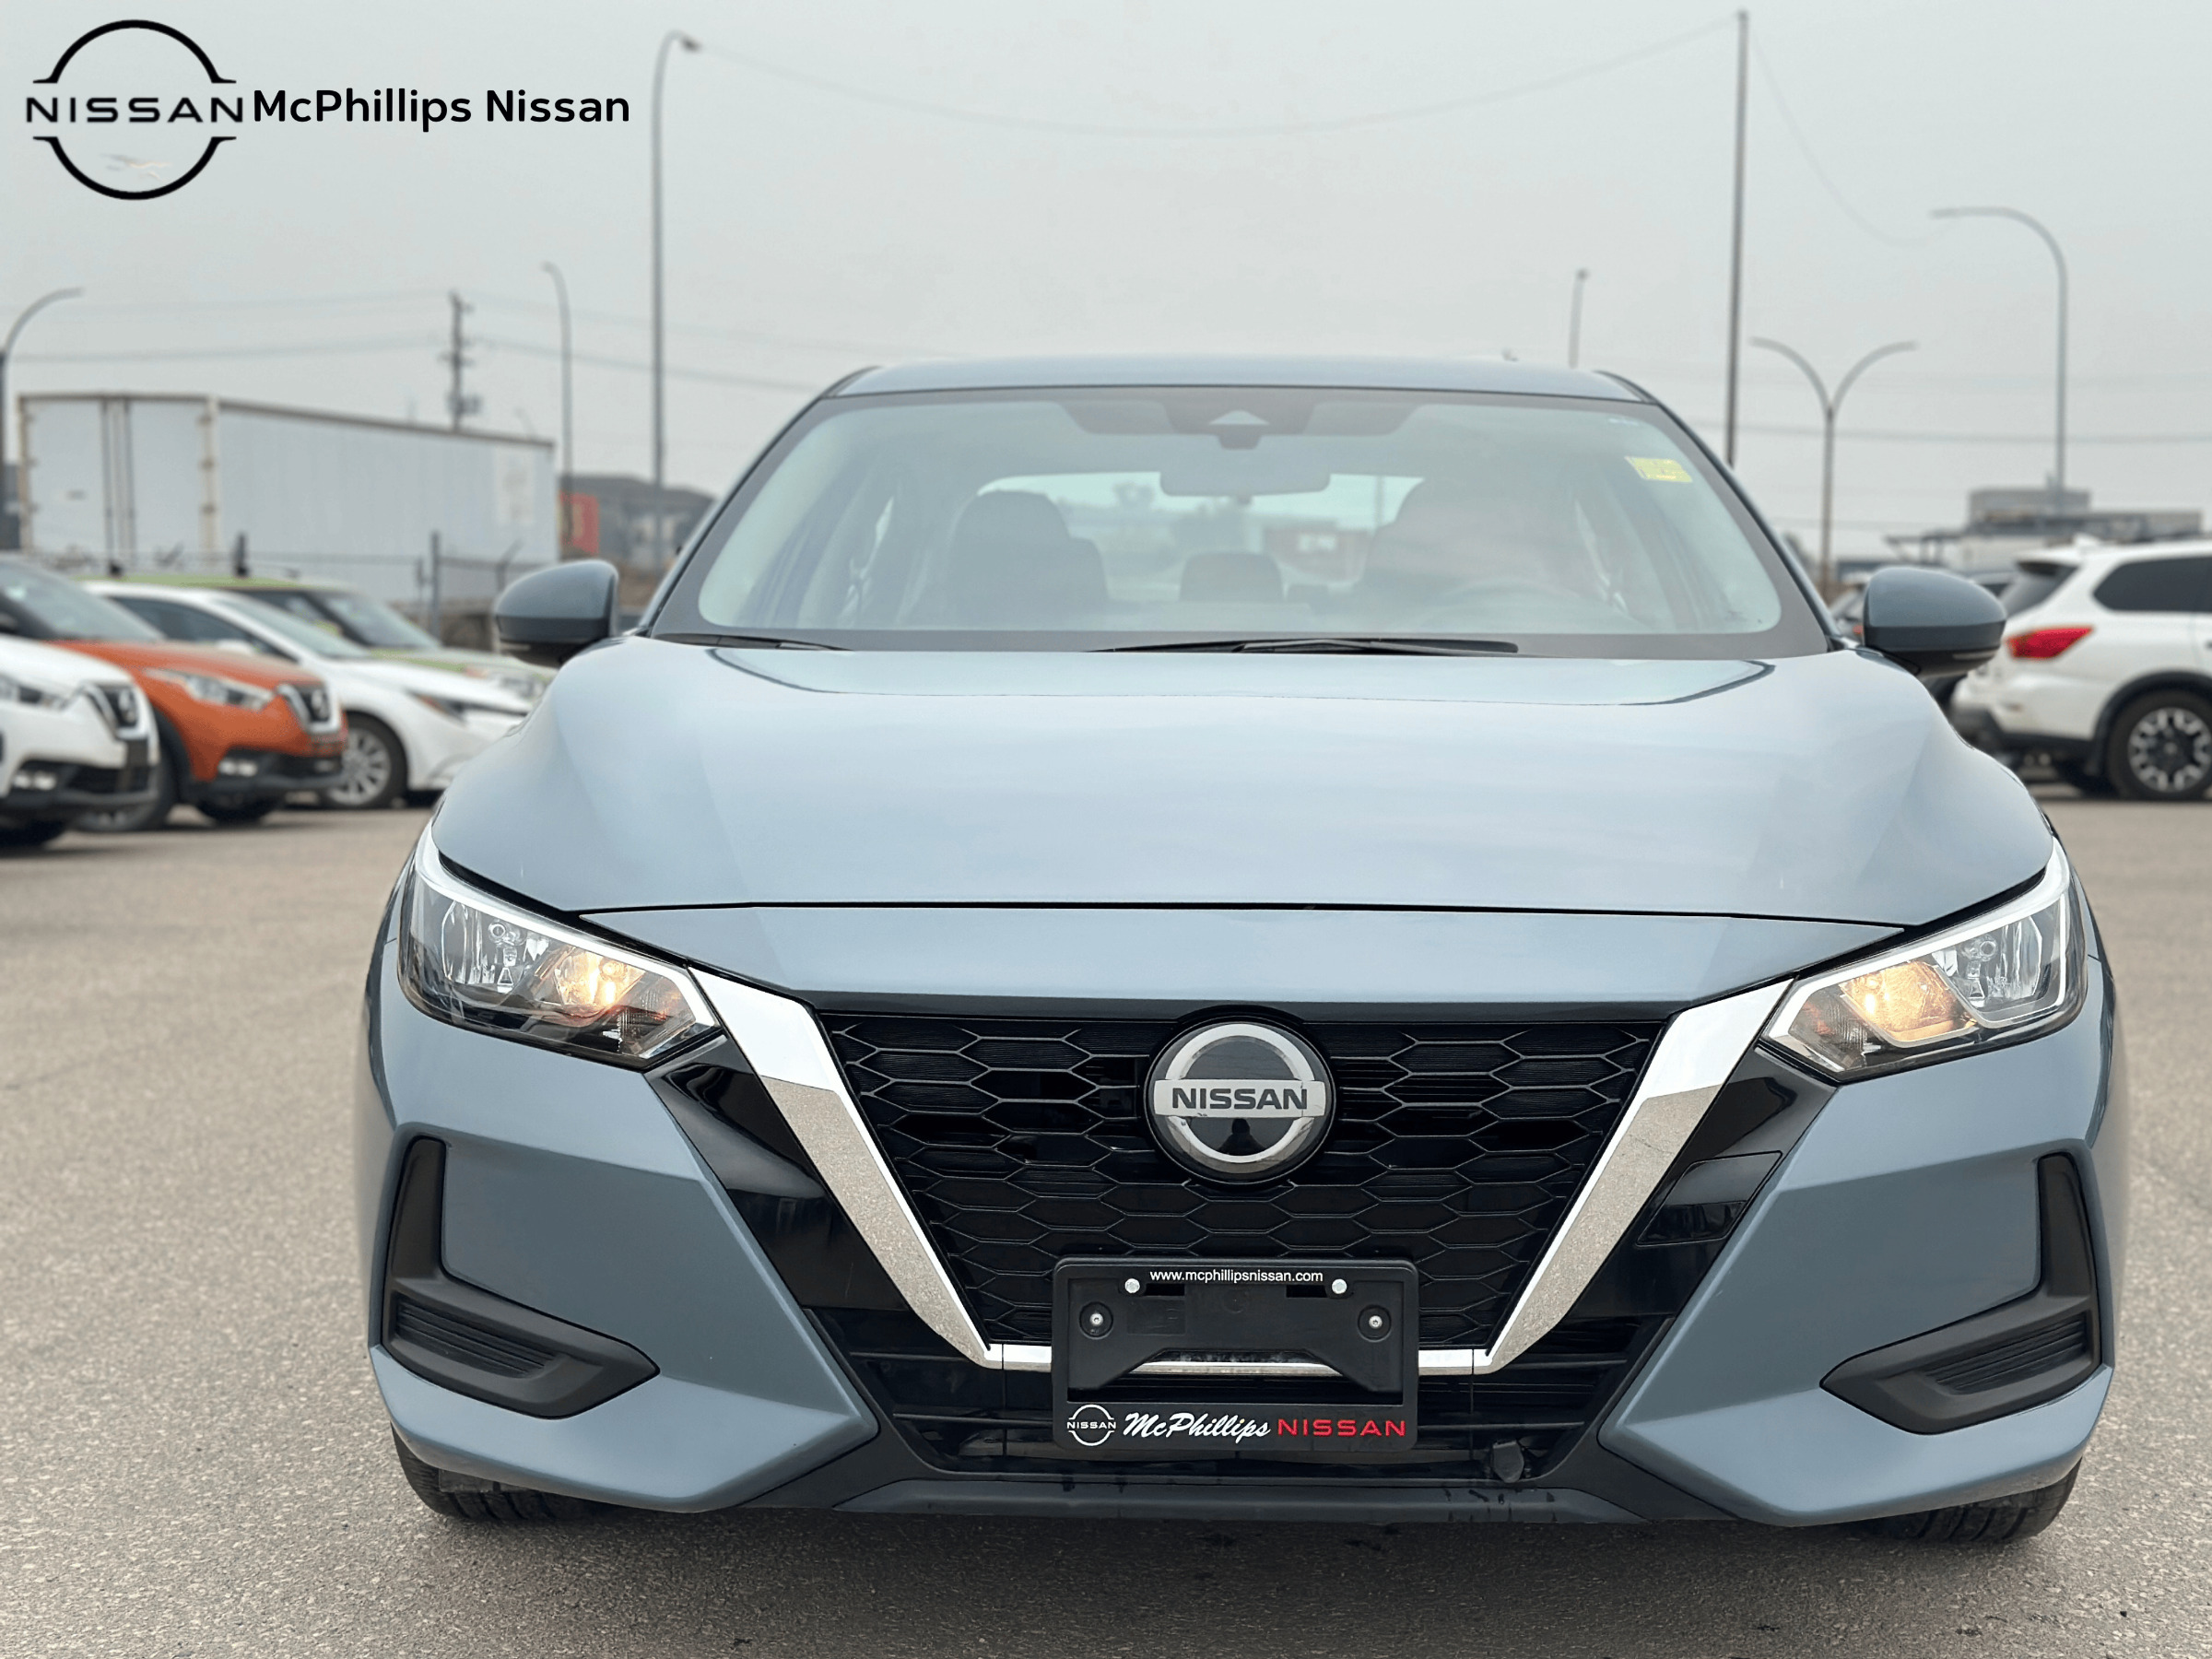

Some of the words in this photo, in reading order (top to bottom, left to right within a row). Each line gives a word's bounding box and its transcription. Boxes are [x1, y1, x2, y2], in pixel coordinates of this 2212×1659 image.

[1171, 1088, 1308, 1110] NISSAN
[1149, 1269, 1324, 1283] www.mcphillipsnissan.com
[1066, 1420, 1117, 1430] NISSAN
[1123, 1411, 1271, 1443] McPhillips
[1277, 1418, 1406, 1437] NISSAN
